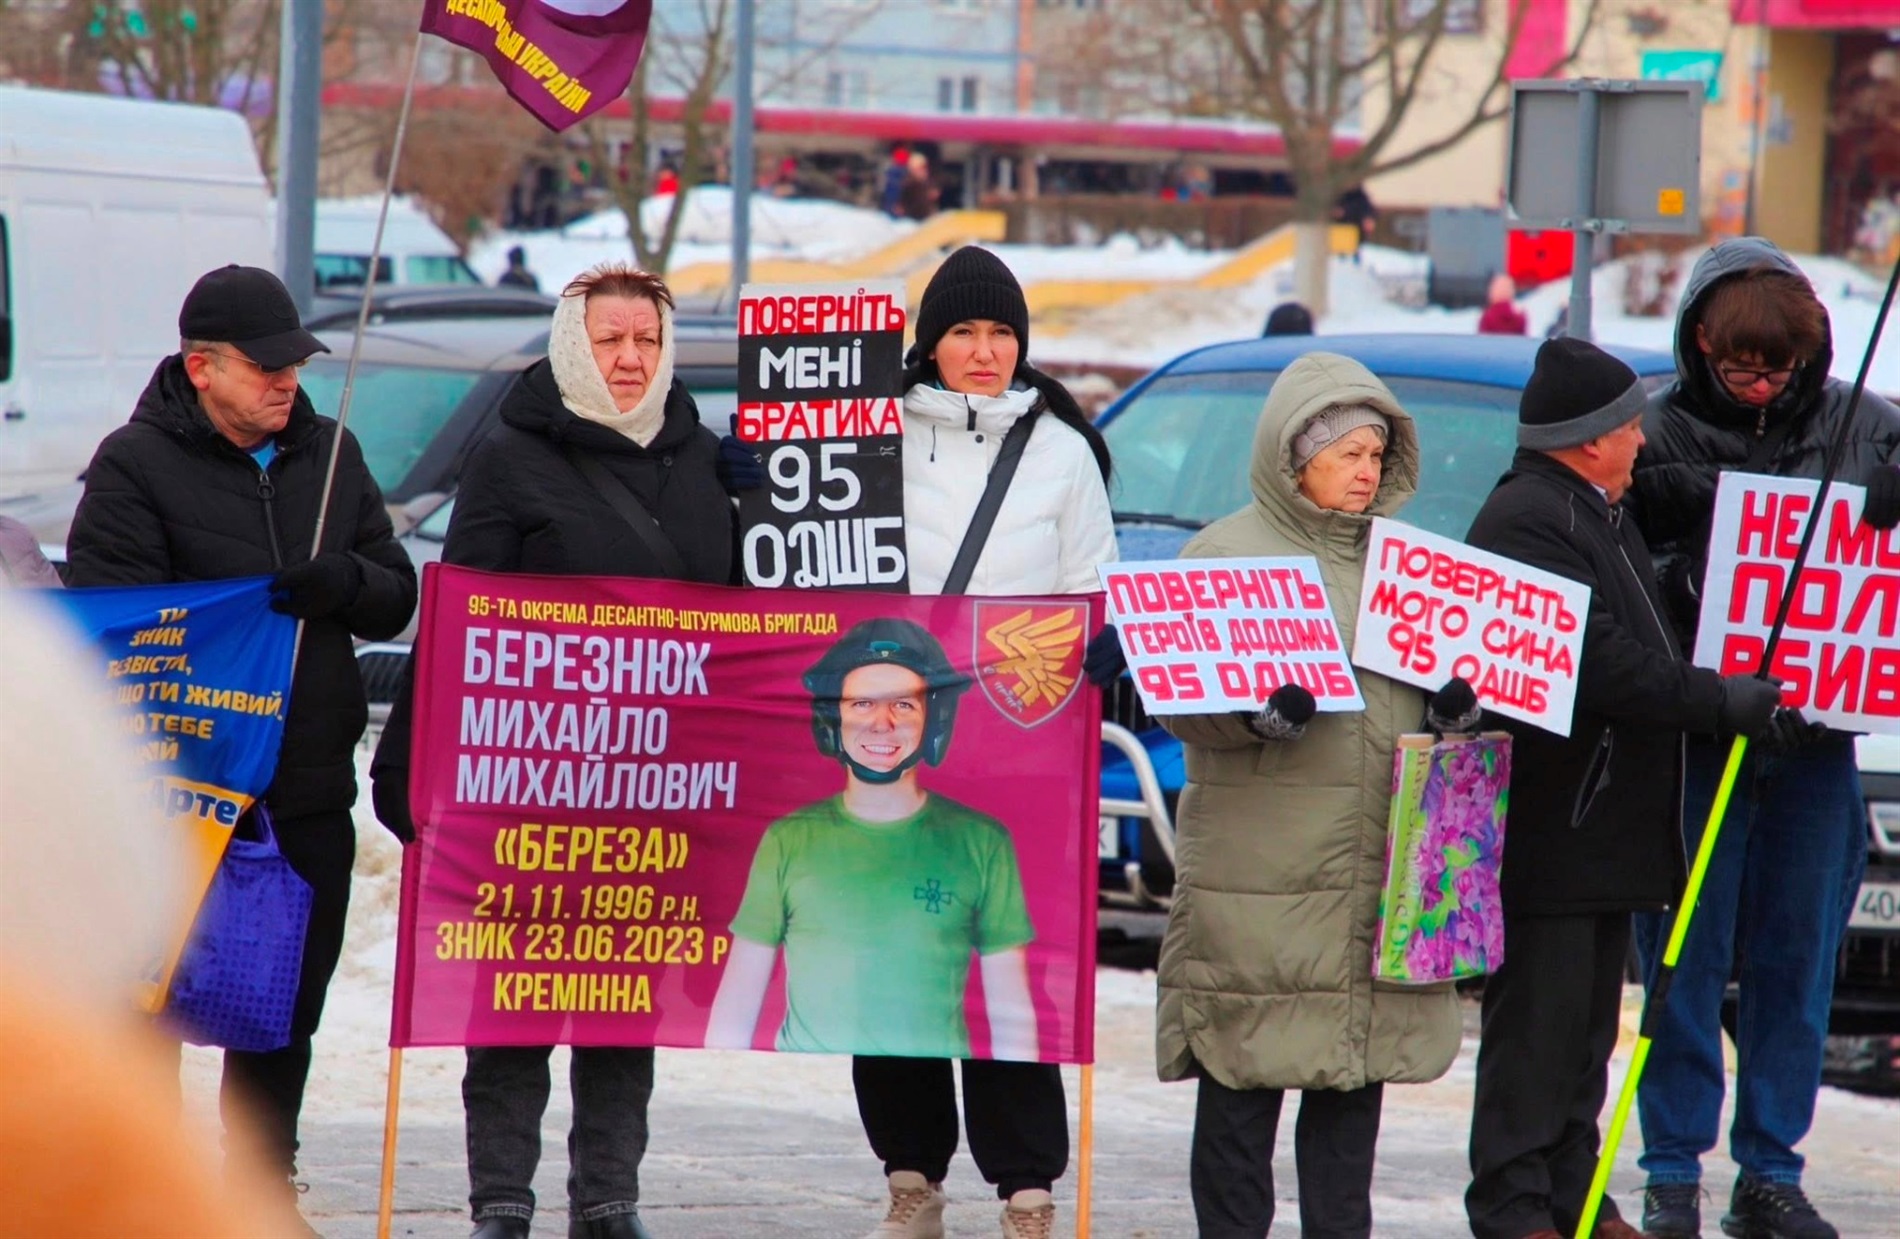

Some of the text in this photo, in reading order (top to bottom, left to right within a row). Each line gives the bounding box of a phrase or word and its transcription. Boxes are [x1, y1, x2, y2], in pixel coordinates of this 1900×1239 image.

[516, 43, 592, 114] УКРАЇНИ
[738, 287, 906, 336] ПОВЕРНІТЬ
[758, 338, 862, 389] МЕНІ
[738, 398, 904, 441] БРАТИКА
[768, 442, 861, 513] 95
[1737, 490, 1810, 560] НЕ
[743, 516, 906, 588] ОДШБ
[1107, 569, 1325, 614] ПОВЕРНІТЬ
[1380, 537, 1577, 633] ПОВЕРНІТЬ
[129, 627, 187, 647] ЗНИК
[158, 608, 188, 624] ТИ
[468, 595, 837, 635] 95-ТА ОКРЕМА ДЕСАНТНО-ШТУРМОВА БРИГАДА
[1123, 612, 1339, 657] ГЕРОЇВ ДОДОМУ
[1369, 580, 1573, 679] МОГО СИНА
[463, 627, 711, 696] БЕРЕЗНЮК
[1137, 661, 1355, 703] 95 ОДШБ
[1387, 622, 1549, 714] 95 ОДШБ
[149, 681, 179, 702] ТИ
[149, 712, 214, 739] ТЕБЕ
[459, 696, 668, 755] МИХАЙЛО
[455, 753, 737, 809] МИХАЙЛОВИЧ
[494, 823, 689, 873] «БЕРЕЗА»
[436, 922, 517, 960] ЗНИК
[524, 924, 704, 965] 23.06.2023
[493, 972, 652, 1013] КРЕМІННА
